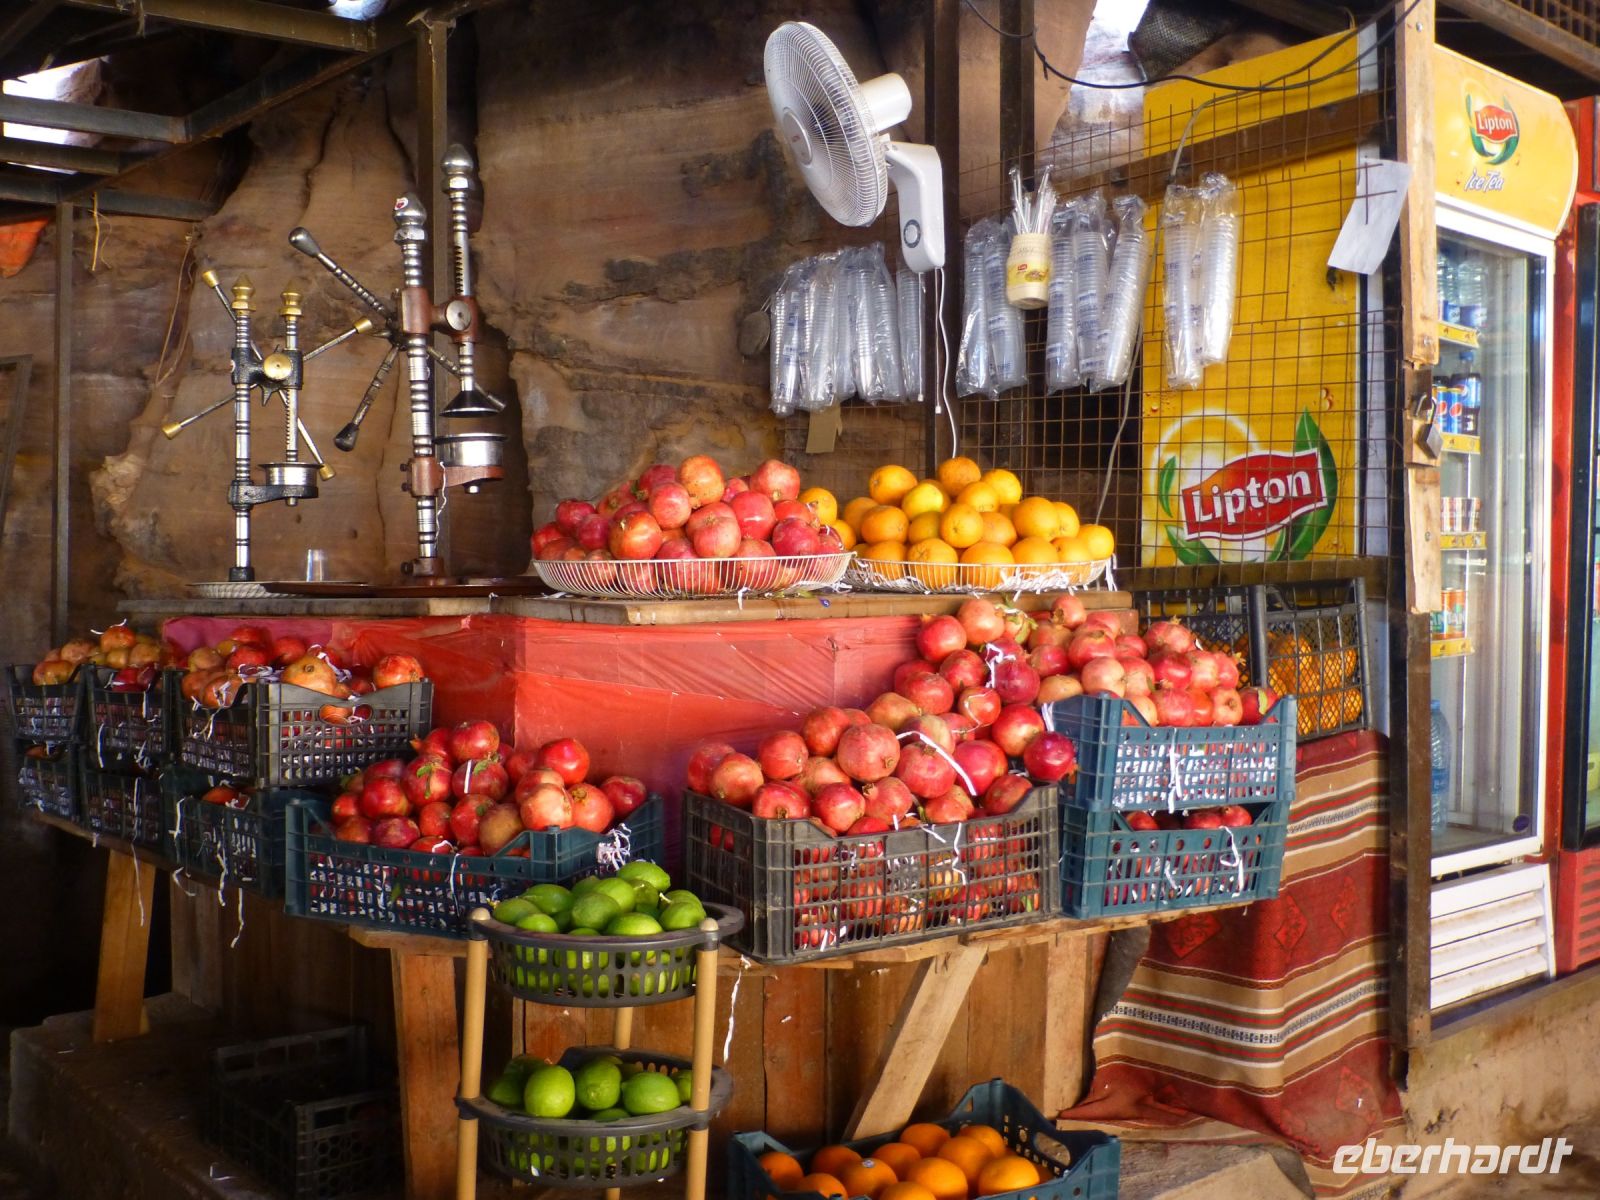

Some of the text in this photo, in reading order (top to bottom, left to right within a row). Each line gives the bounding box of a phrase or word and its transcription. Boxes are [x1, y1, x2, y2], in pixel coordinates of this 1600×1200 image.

[1478, 112, 1513, 134] Lipton
[1465, 169, 1504, 191] Ice Tea
[1191, 470, 1312, 526] Lipton
